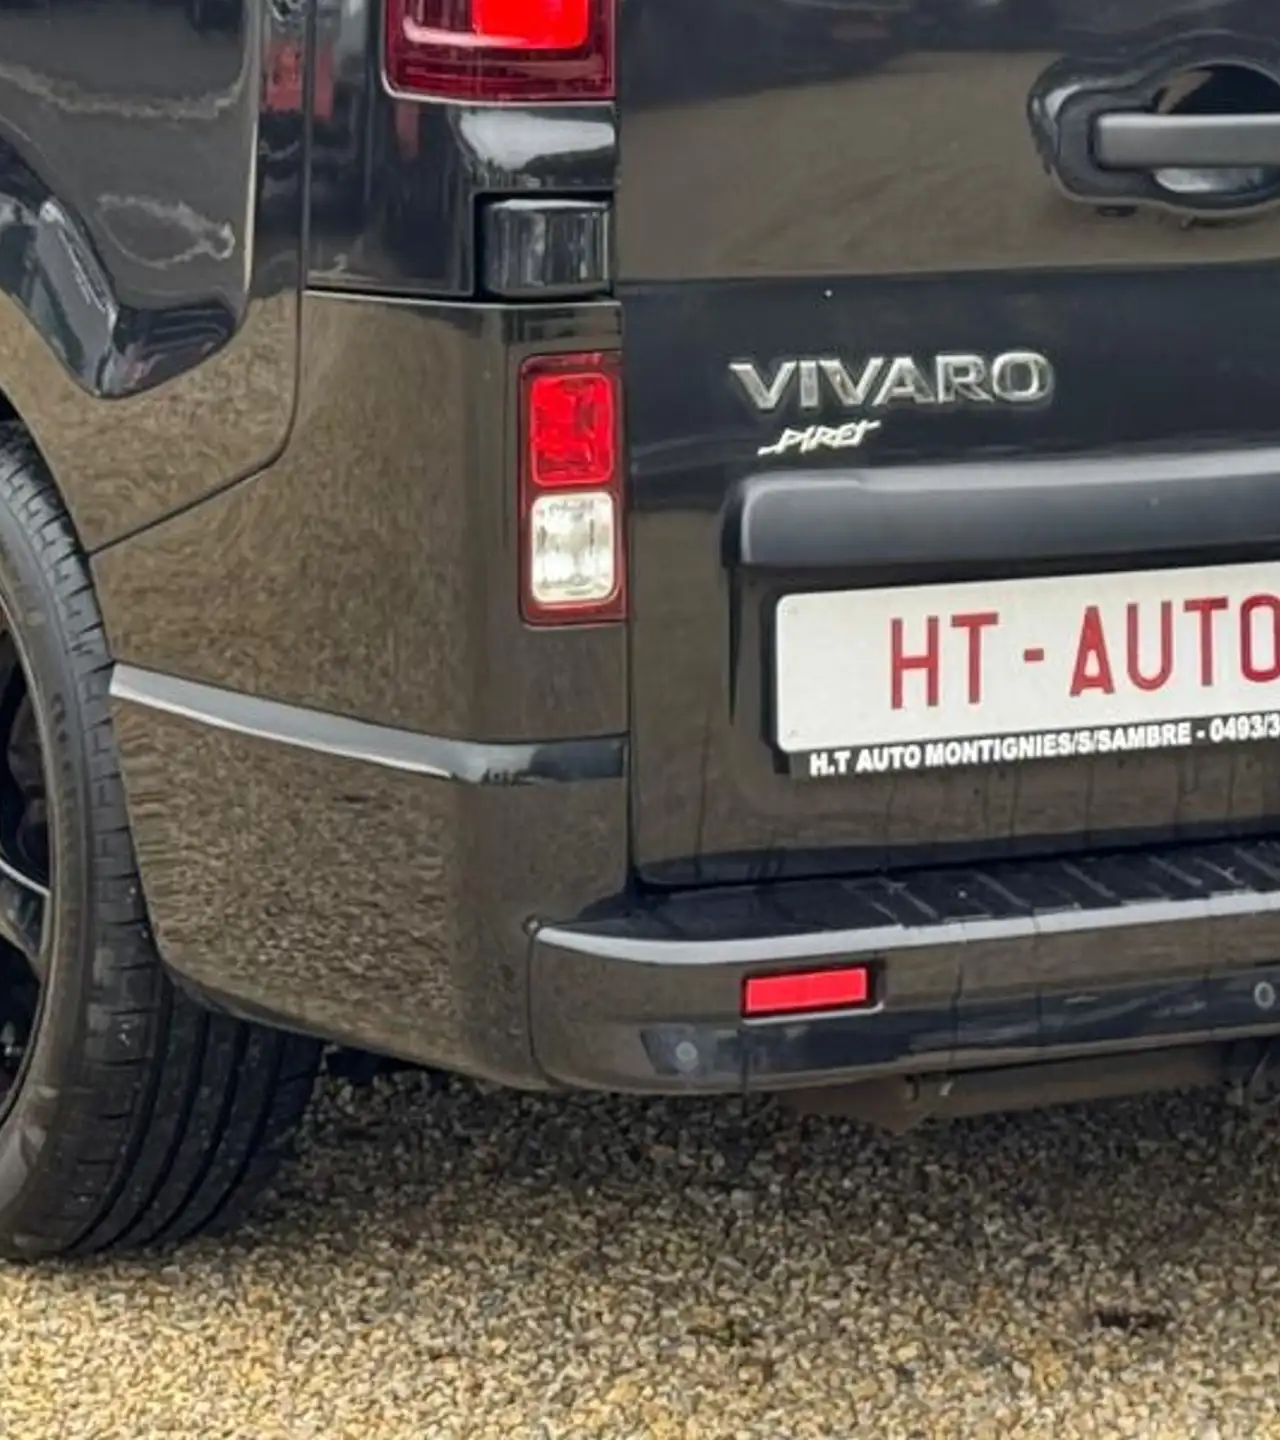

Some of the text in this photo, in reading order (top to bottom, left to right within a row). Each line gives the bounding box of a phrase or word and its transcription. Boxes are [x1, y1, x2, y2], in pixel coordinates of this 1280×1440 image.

[728, 351, 1054, 410] VIVARO
[890, 611, 999, 709] HT
[809, 749, 851, 777] H.T
[855, 742, 921, 774] AUTO
